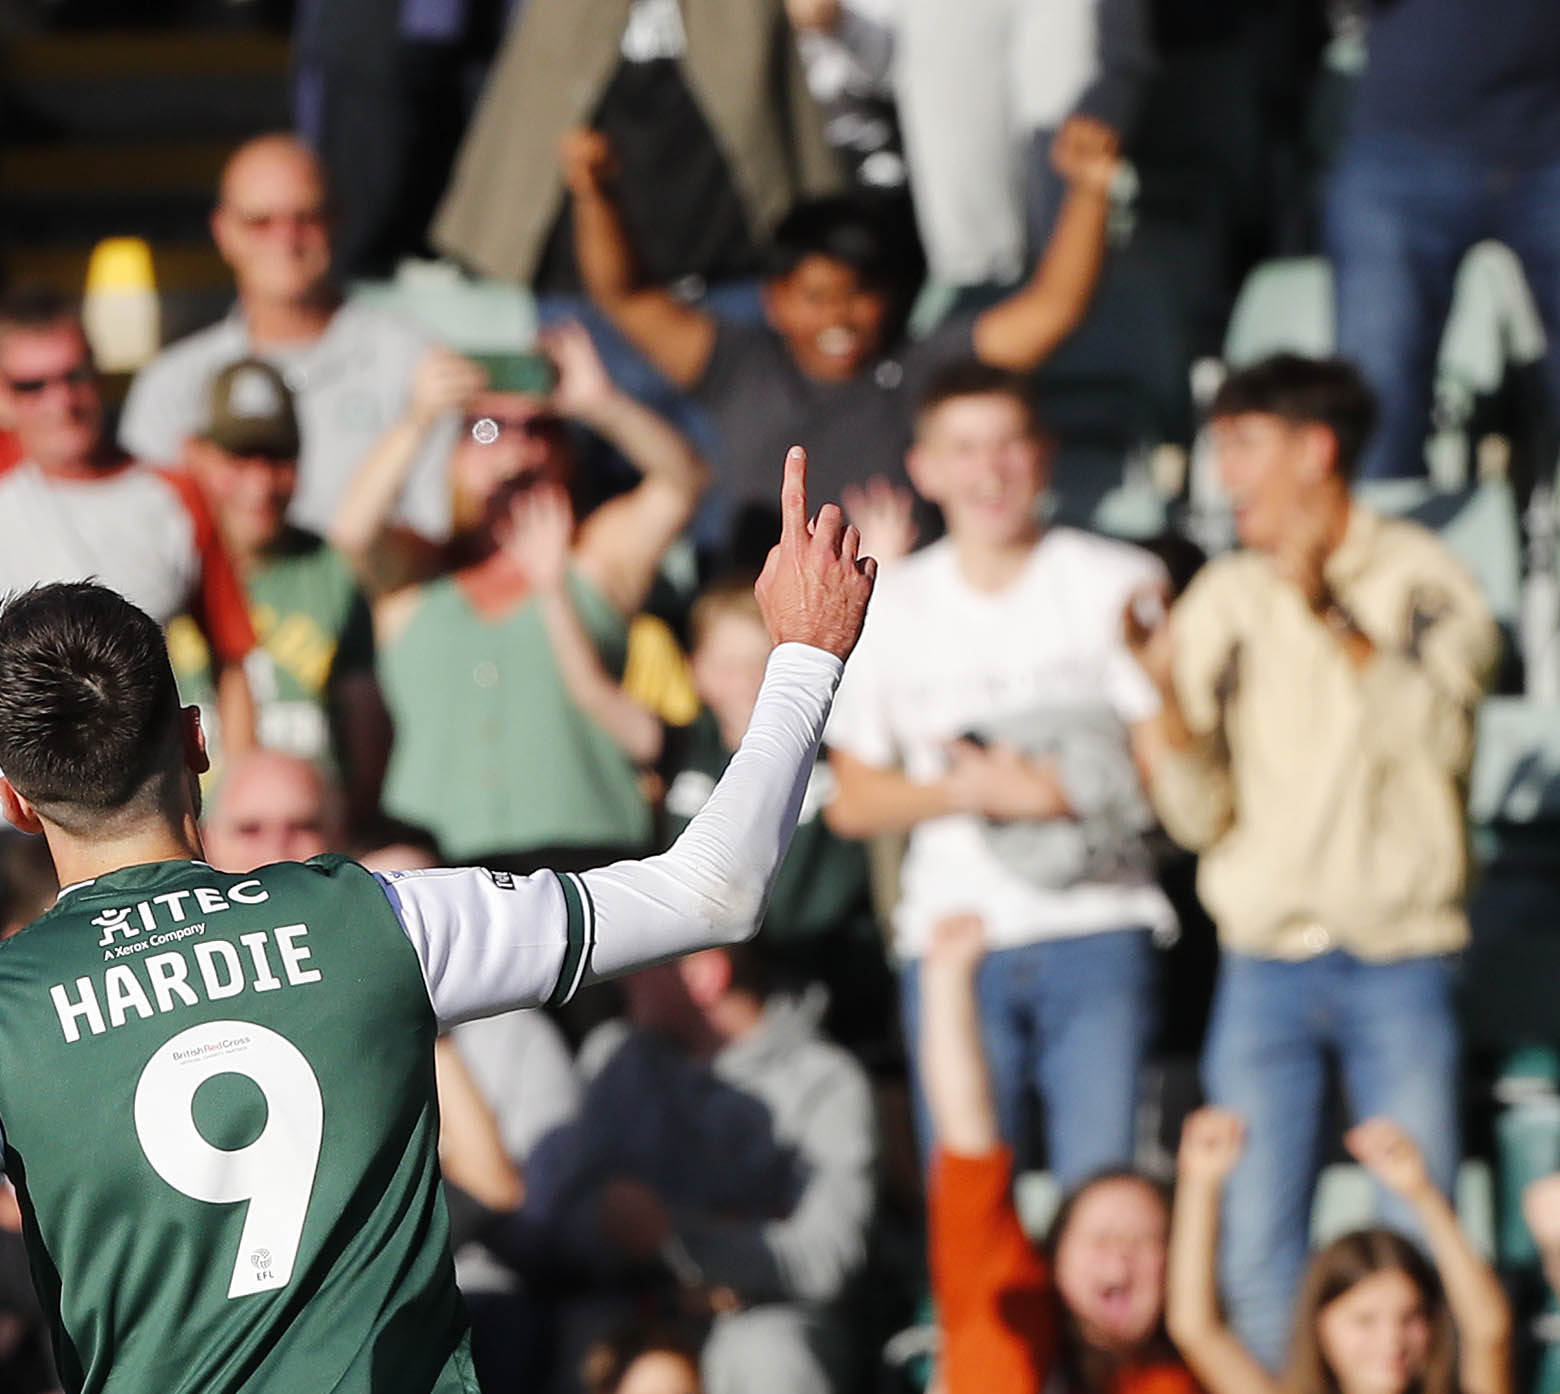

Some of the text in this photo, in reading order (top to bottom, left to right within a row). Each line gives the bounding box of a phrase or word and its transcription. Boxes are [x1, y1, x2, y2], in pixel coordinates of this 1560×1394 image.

[104, 922, 205, 961] A Xerox Company
[49, 923, 322, 1043] HARDIE
[134, 1019, 324, 1299] 9
[256, 1270, 274, 1281] EFL
